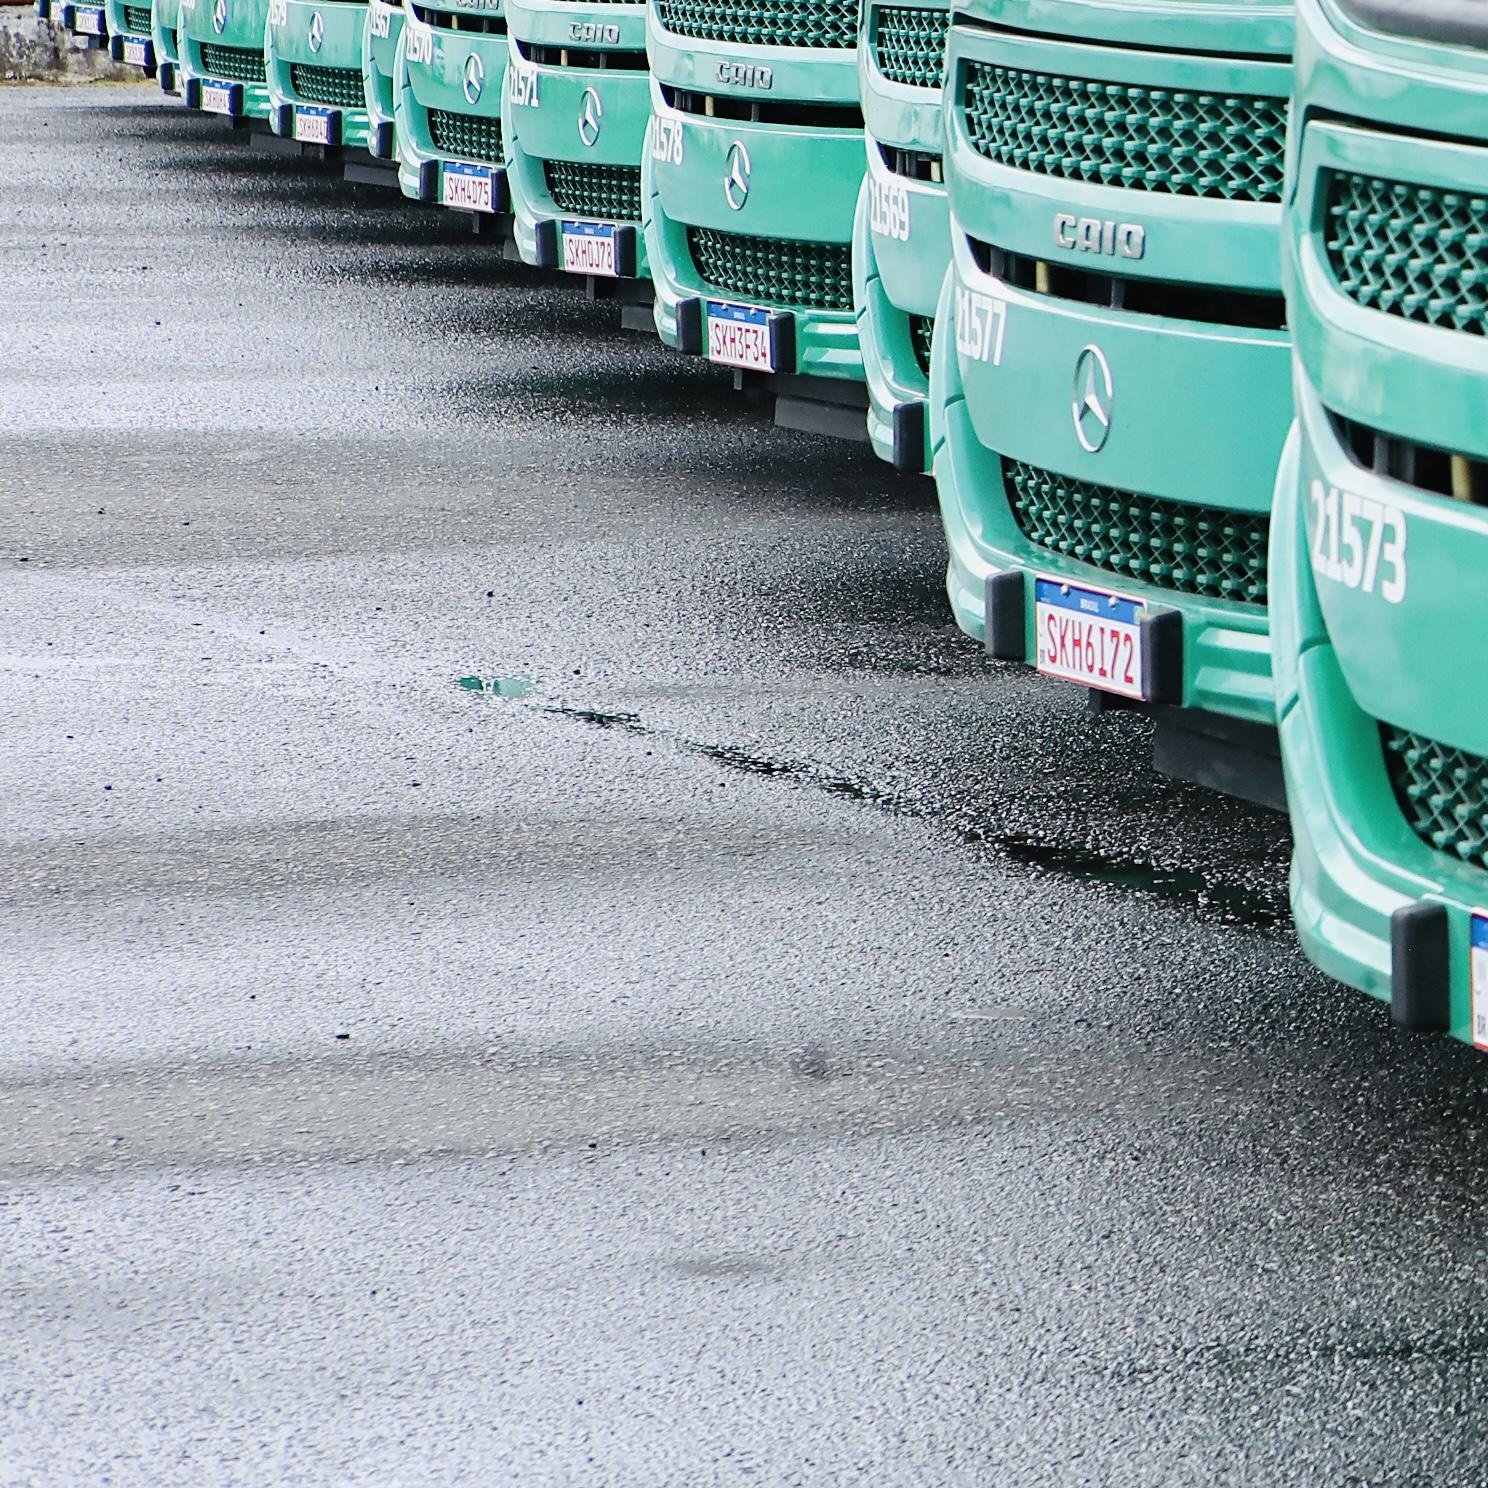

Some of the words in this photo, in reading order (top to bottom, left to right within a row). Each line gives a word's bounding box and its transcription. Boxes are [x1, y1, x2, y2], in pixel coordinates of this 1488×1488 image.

[569, 22, 620, 44] CAIO
[715, 59, 774, 90] CAIO
[1053, 212, 1146, 260] CAIO
[714, 322, 768, 362] SKH3F34
[1310, 479, 1407, 604] 21573
